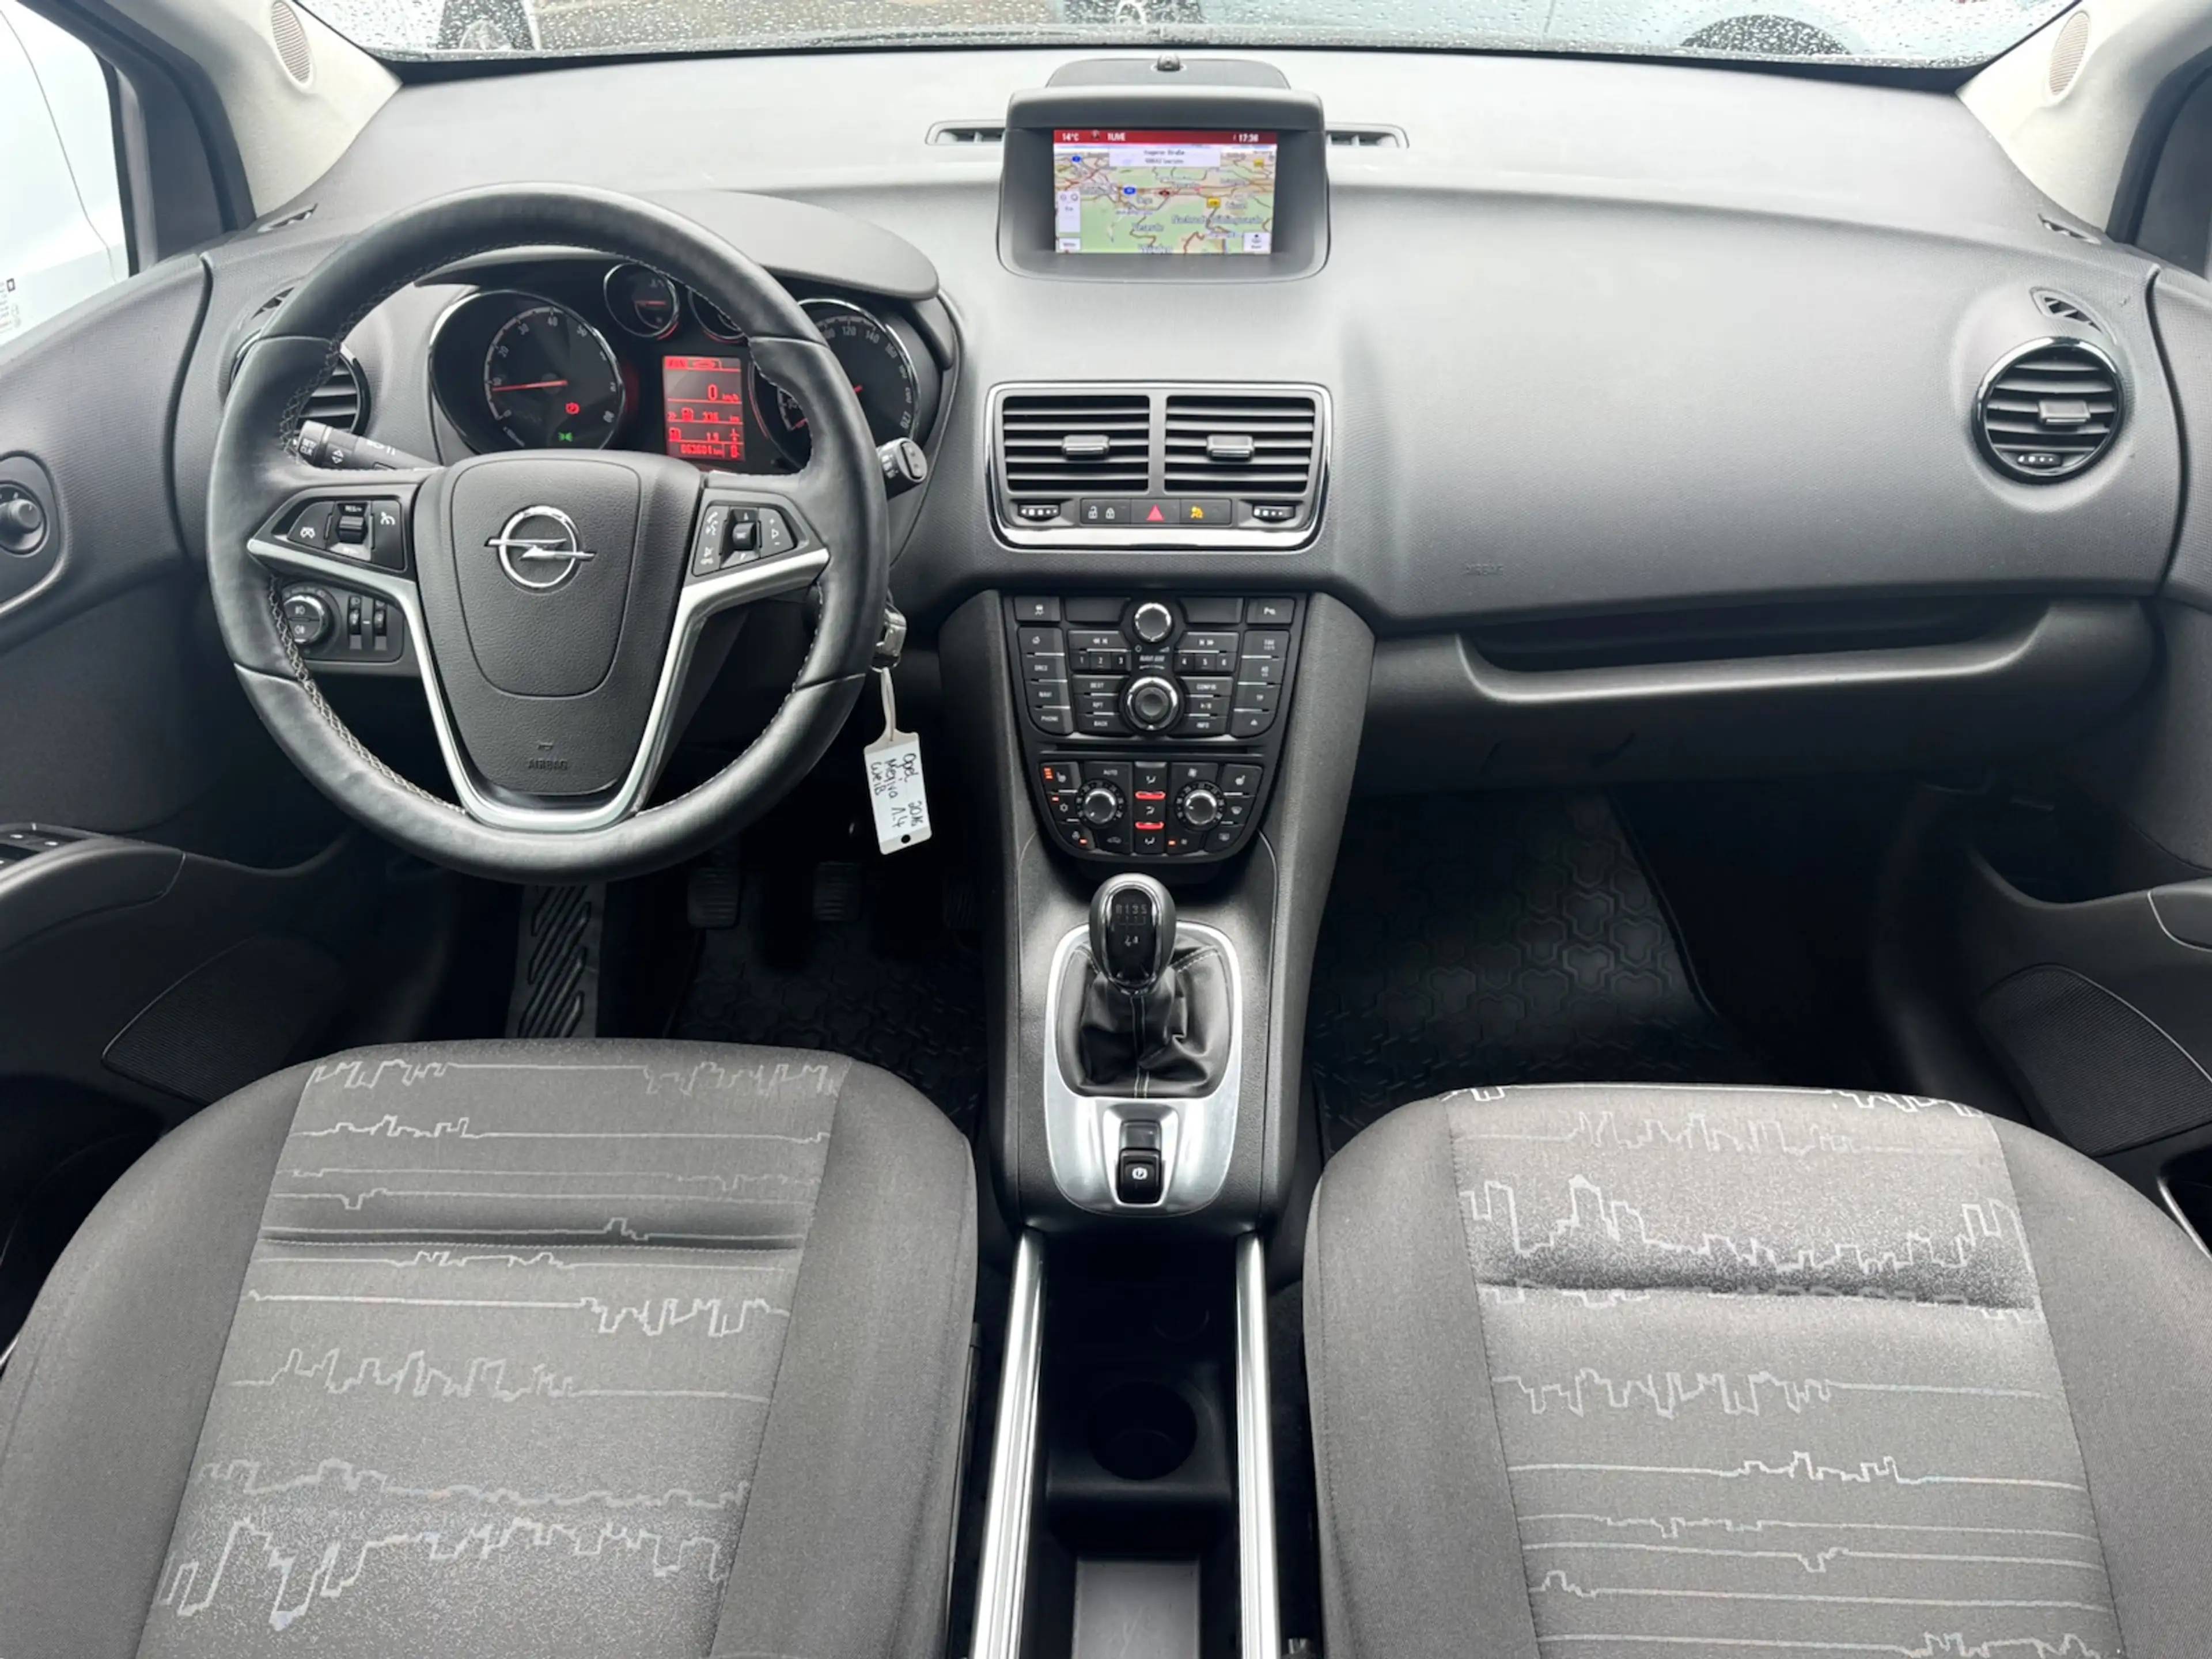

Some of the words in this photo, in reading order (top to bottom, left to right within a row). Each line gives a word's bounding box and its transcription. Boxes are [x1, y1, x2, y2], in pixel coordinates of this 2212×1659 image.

[842, 325, 857, 336] 120
[865, 330, 880, 343] 140
[707, 383, 718, 401] 0
[1080, 656, 1084, 664] 1
[1118, 657, 1124, 665] 3
[1132, 904, 1139, 915] 3
